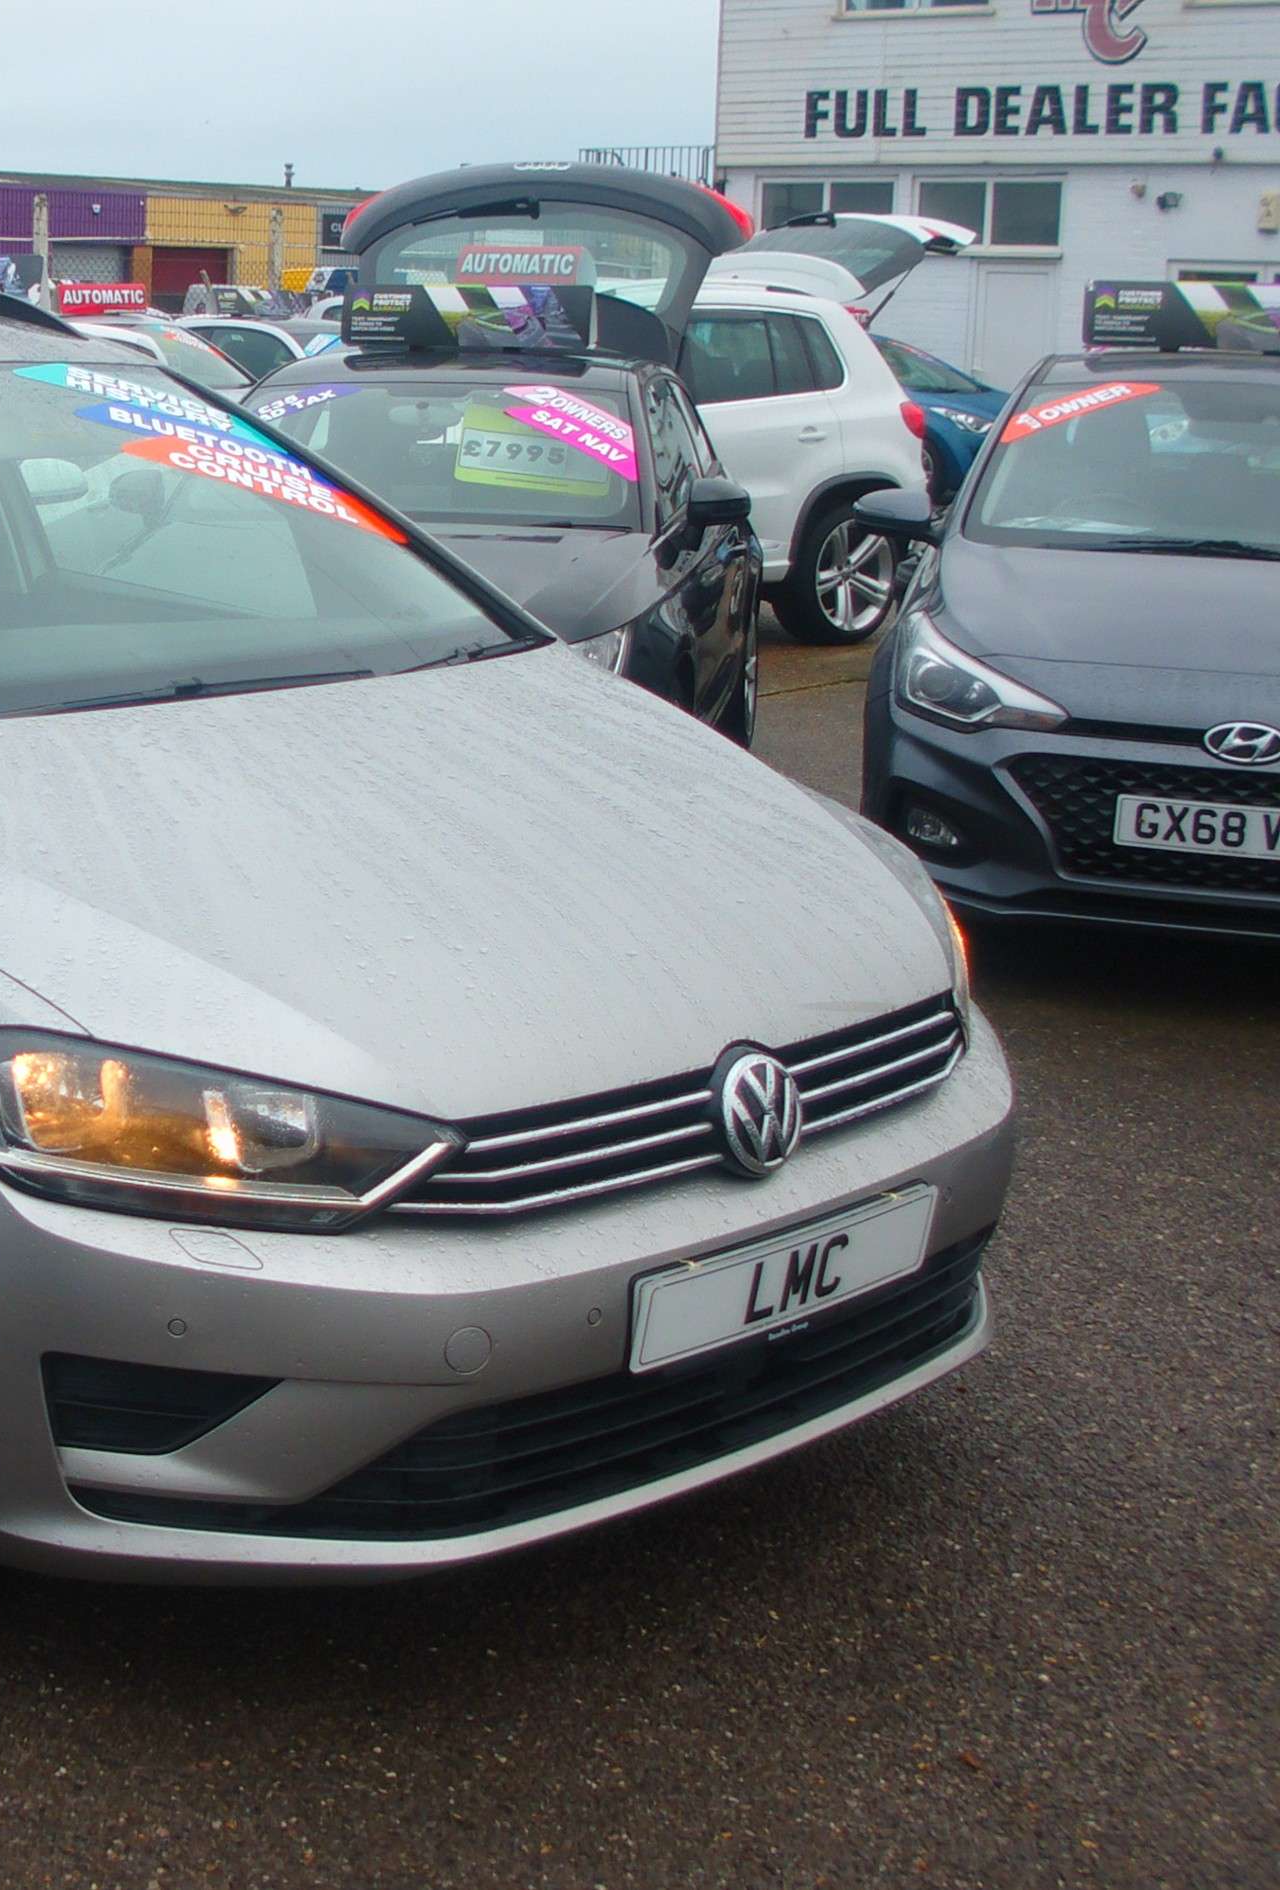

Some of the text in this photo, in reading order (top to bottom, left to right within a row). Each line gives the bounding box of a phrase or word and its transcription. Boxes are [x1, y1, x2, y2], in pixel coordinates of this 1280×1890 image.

[805, 88, 927, 138] FULL
[954, 82, 1180, 136] DEALER
[460, 253, 575, 275] AUTOMATIC
[63, 289, 144, 304] AUTOMATIC
[66, 375, 233, 432] HISTORY
[67, 366, 231, 421] SERVICE
[294, 389, 336, 409] TAX
[548, 397, 627, 440] OWNERS
[1039, 385, 1131, 420] OWNER
[109, 407, 312, 480] BLUETOOTH
[463, 439, 568, 465] £7995
[531, 410, 628, 462] SAT NAV
[169, 452, 359, 524] CONTROL
[187, 445, 334, 502] CRUISE
[1134, 803, 1247, 848] GX68
[744, 1233, 849, 1325] LMC
